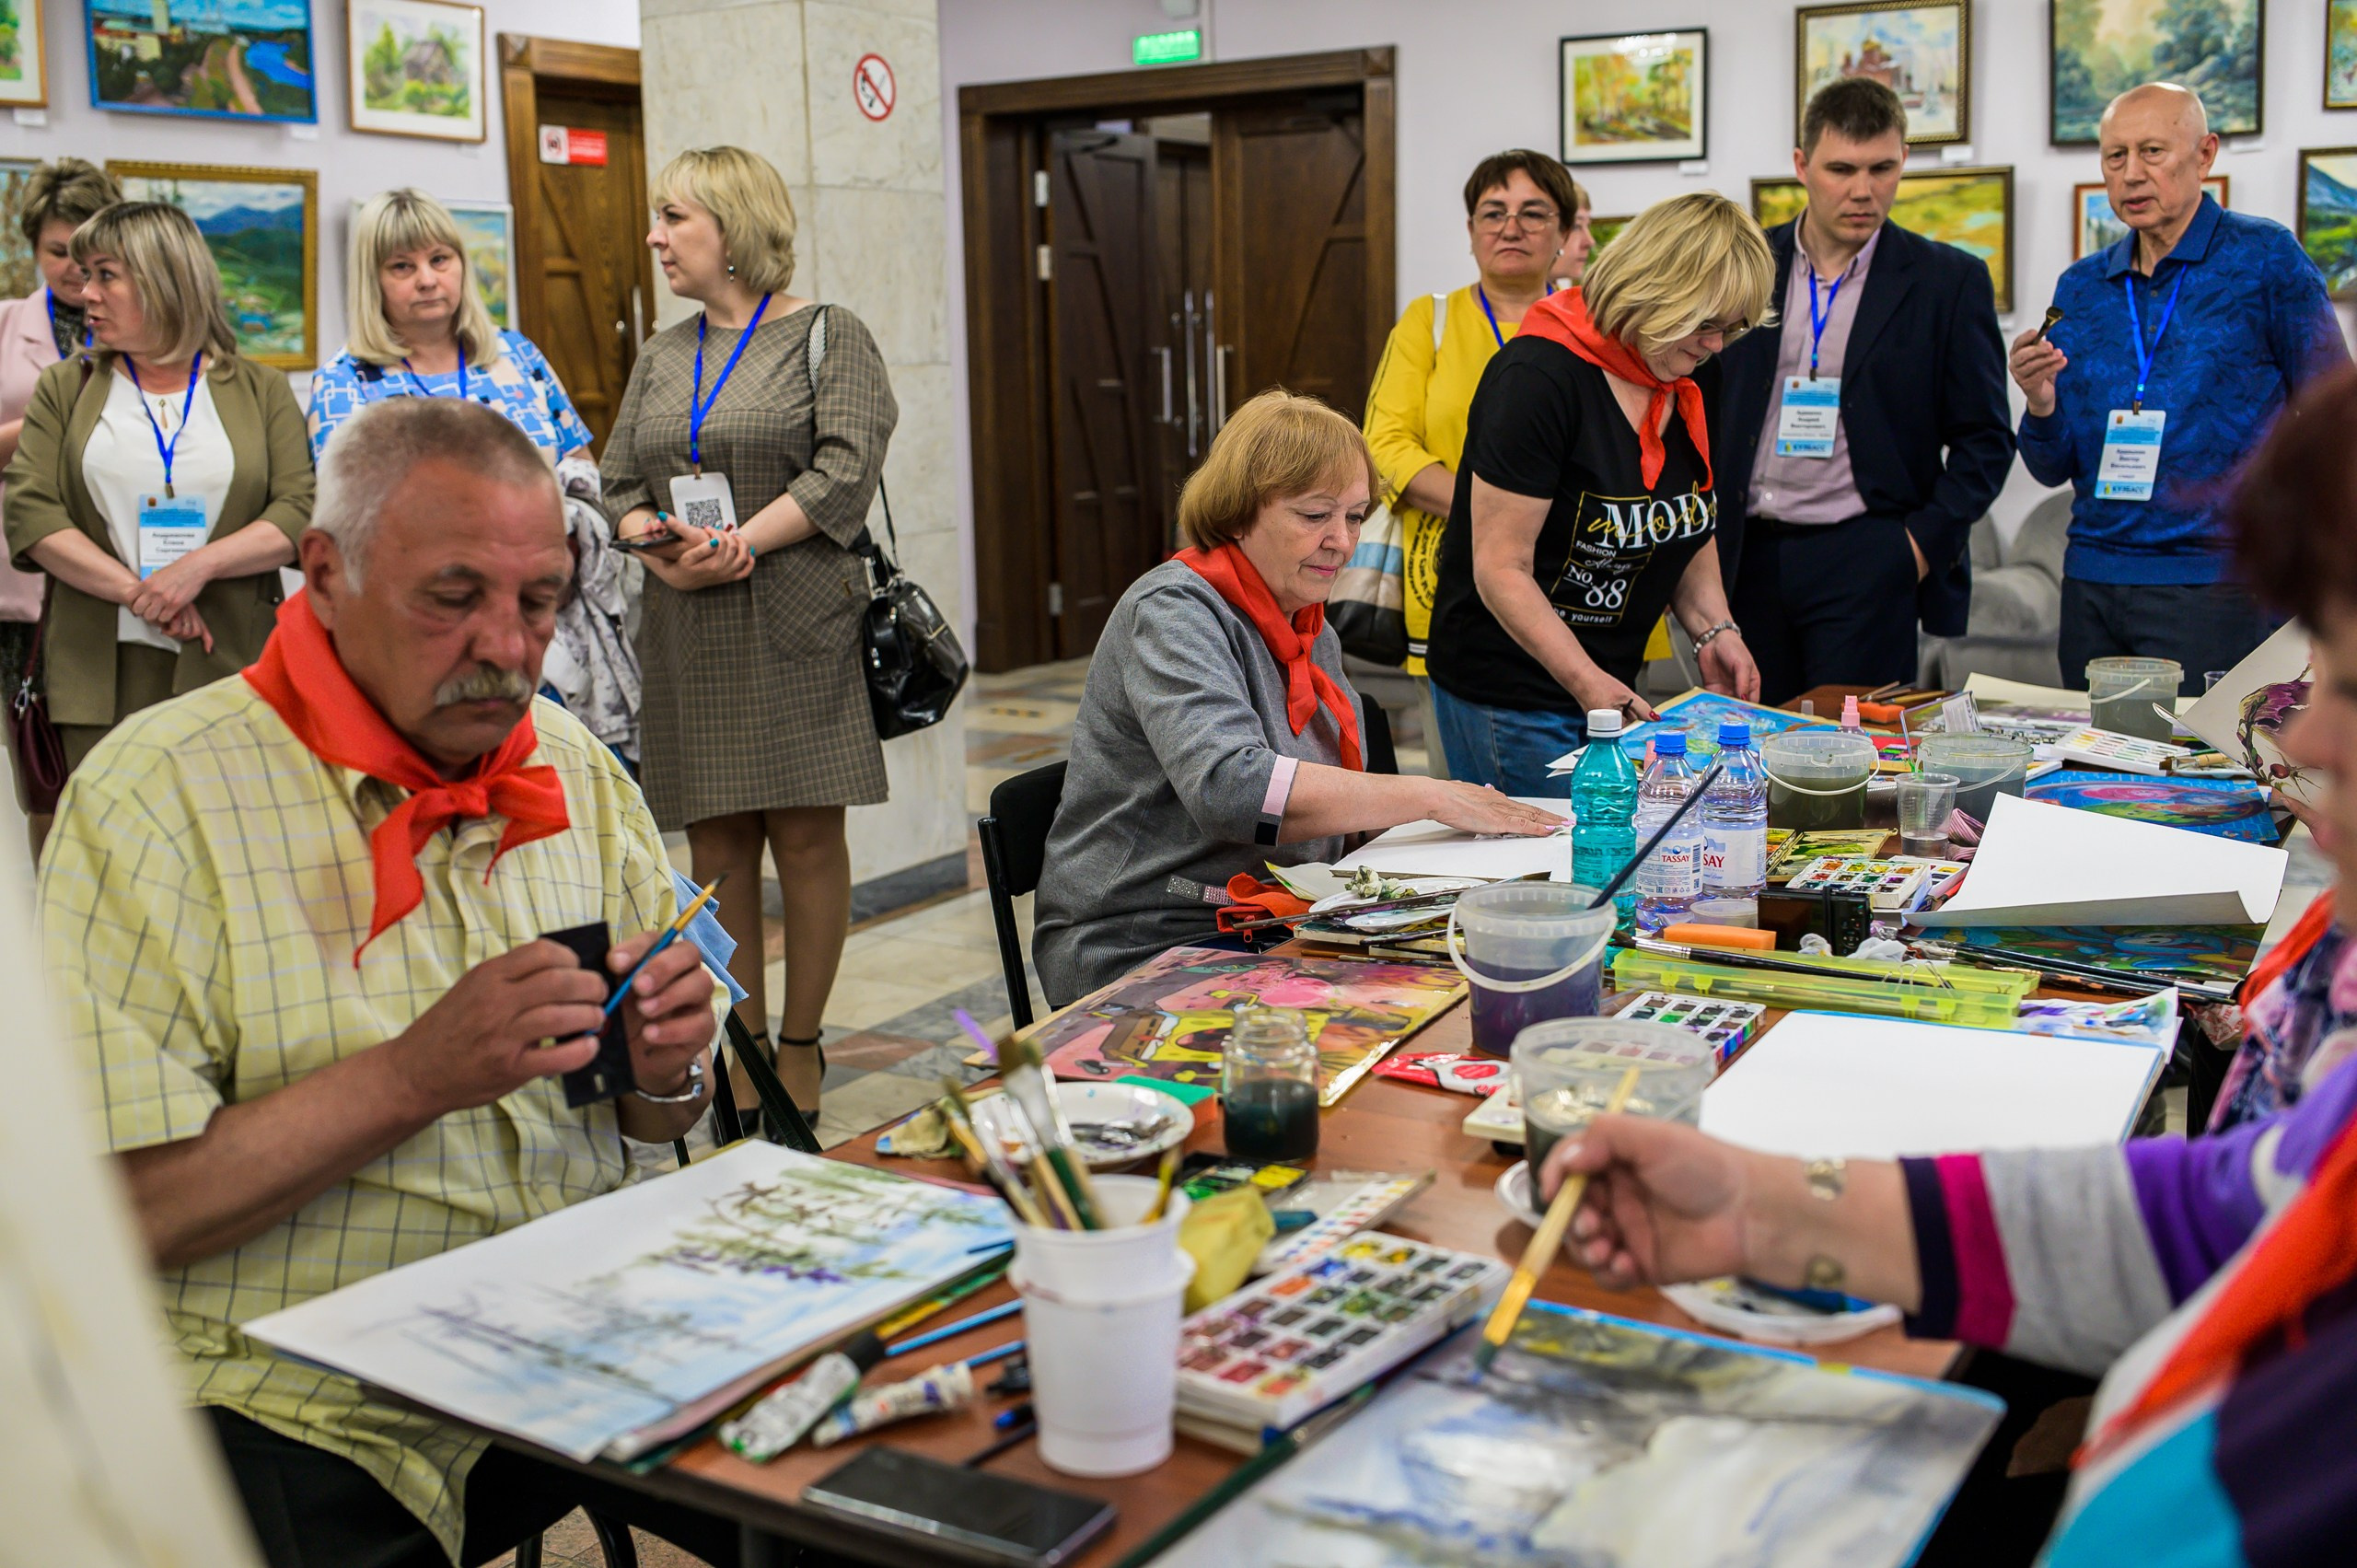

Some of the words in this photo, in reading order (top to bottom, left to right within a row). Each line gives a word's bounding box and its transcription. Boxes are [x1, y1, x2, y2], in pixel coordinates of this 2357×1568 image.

[2112, 485, 2145, 494] КУЗБАСС
[1575, 540, 1617, 558] FASHION
[1567, 564, 1594, 586] No.
[1585, 578, 1627, 610] 88
[1571, 612, 1613, 623] yourself
[1661, 854, 1691, 863] TASSAY
[1702, 854, 1725, 868] SAY
